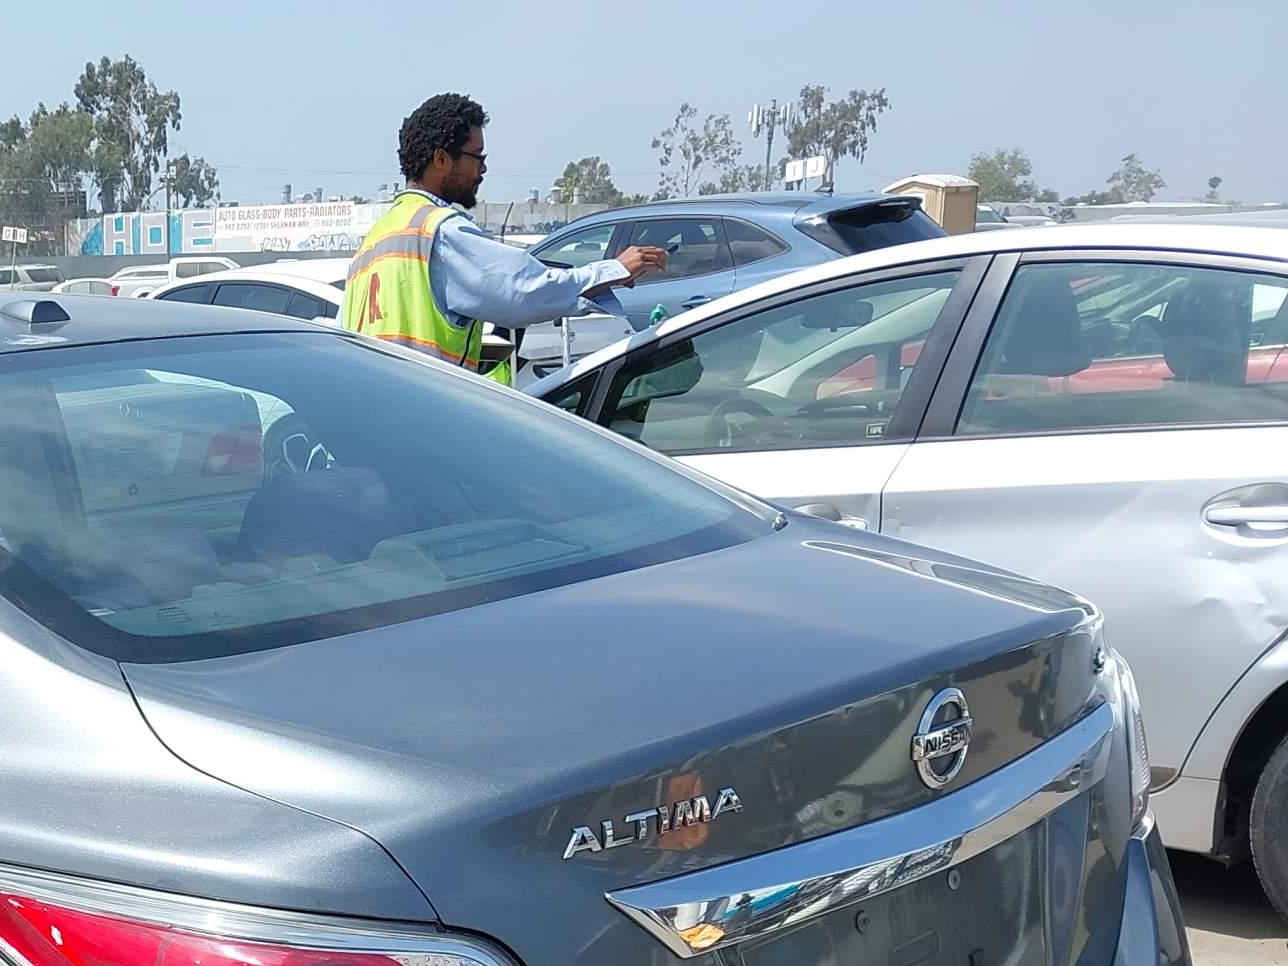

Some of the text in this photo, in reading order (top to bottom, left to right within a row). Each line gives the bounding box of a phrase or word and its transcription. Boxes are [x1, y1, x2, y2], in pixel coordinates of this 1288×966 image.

[218, 211, 235, 221] AUTO
[4, 228, 11, 239] G
[925, 722, 970, 753] NISSAN
[562, 787, 744, 860] ALTIMA
